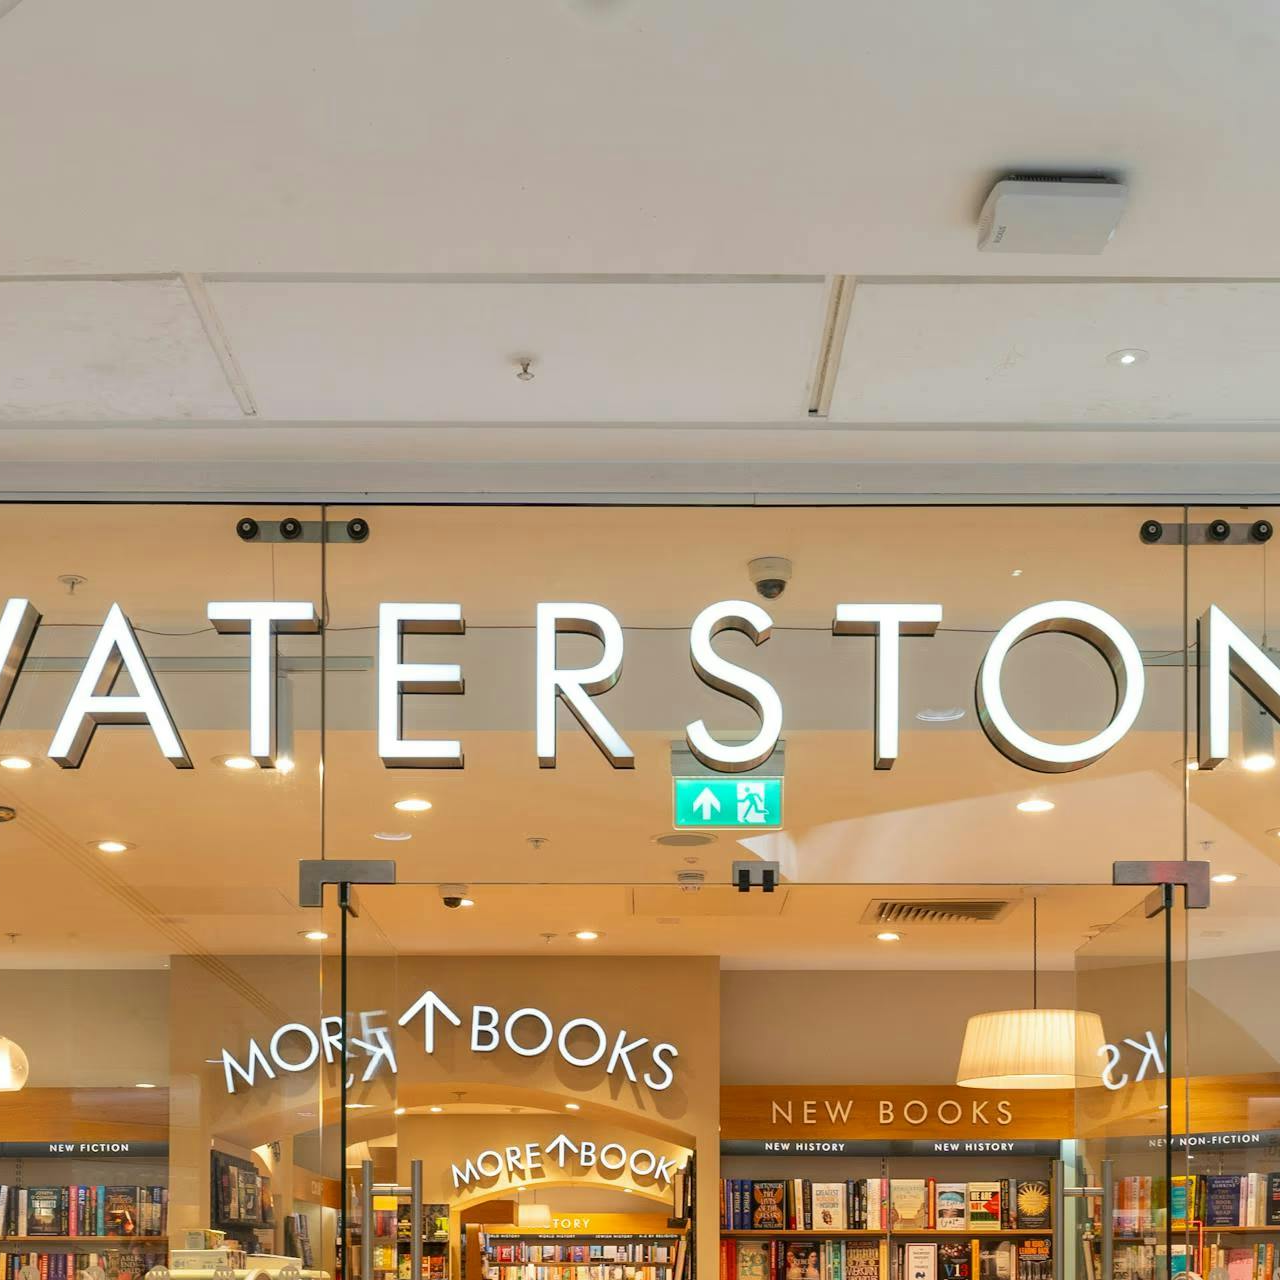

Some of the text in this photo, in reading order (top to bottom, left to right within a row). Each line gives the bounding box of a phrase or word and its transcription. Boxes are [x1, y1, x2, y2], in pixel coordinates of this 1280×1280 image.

[471, 1004, 680, 1092] BOOKS
[771, 1099, 1014, 1125] NEW BOOKS
[765, 1142, 846, 1151] NEW HISTORY
[934, 1142, 1015, 1151] NEW HISTORY
[1148, 1134, 1260, 1147] NEW NON-FICTION
[49, 1143, 129, 1152] NEW FICTION
[451, 1141, 677, 1188] MORE BOOK
[544, 1218, 590, 1229] TORY
[945, 1264, 968, 1276] V13
